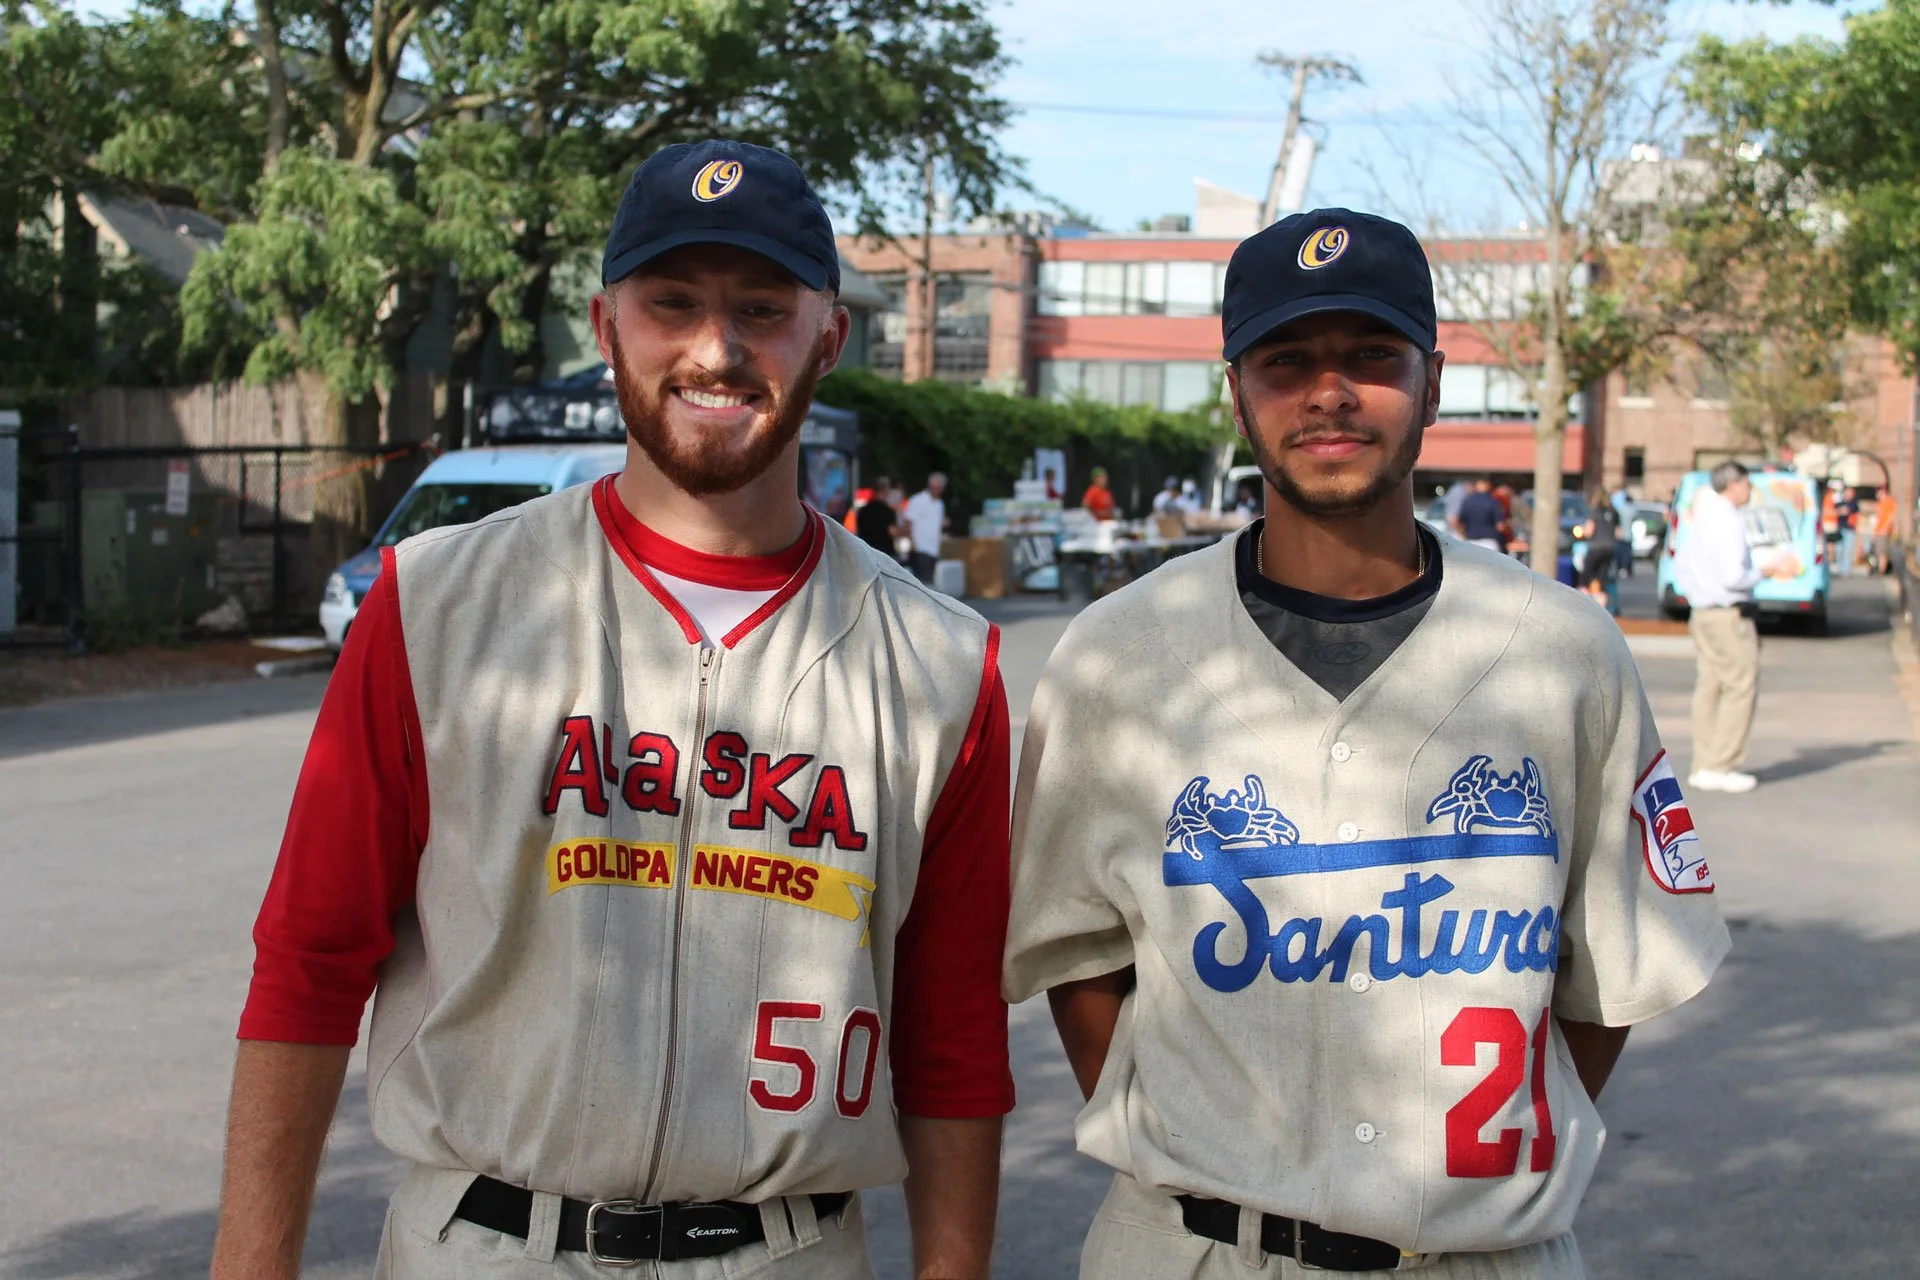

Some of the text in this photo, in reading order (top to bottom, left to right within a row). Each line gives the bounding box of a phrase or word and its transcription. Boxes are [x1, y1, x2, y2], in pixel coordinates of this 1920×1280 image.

[1650, 785, 1663, 812] 1
[1656, 814, 1673, 845] 2
[1667, 843, 1684, 872] 3
[747, 1000, 883, 1120] 50
[1440, 1006, 1557, 1178] 21
